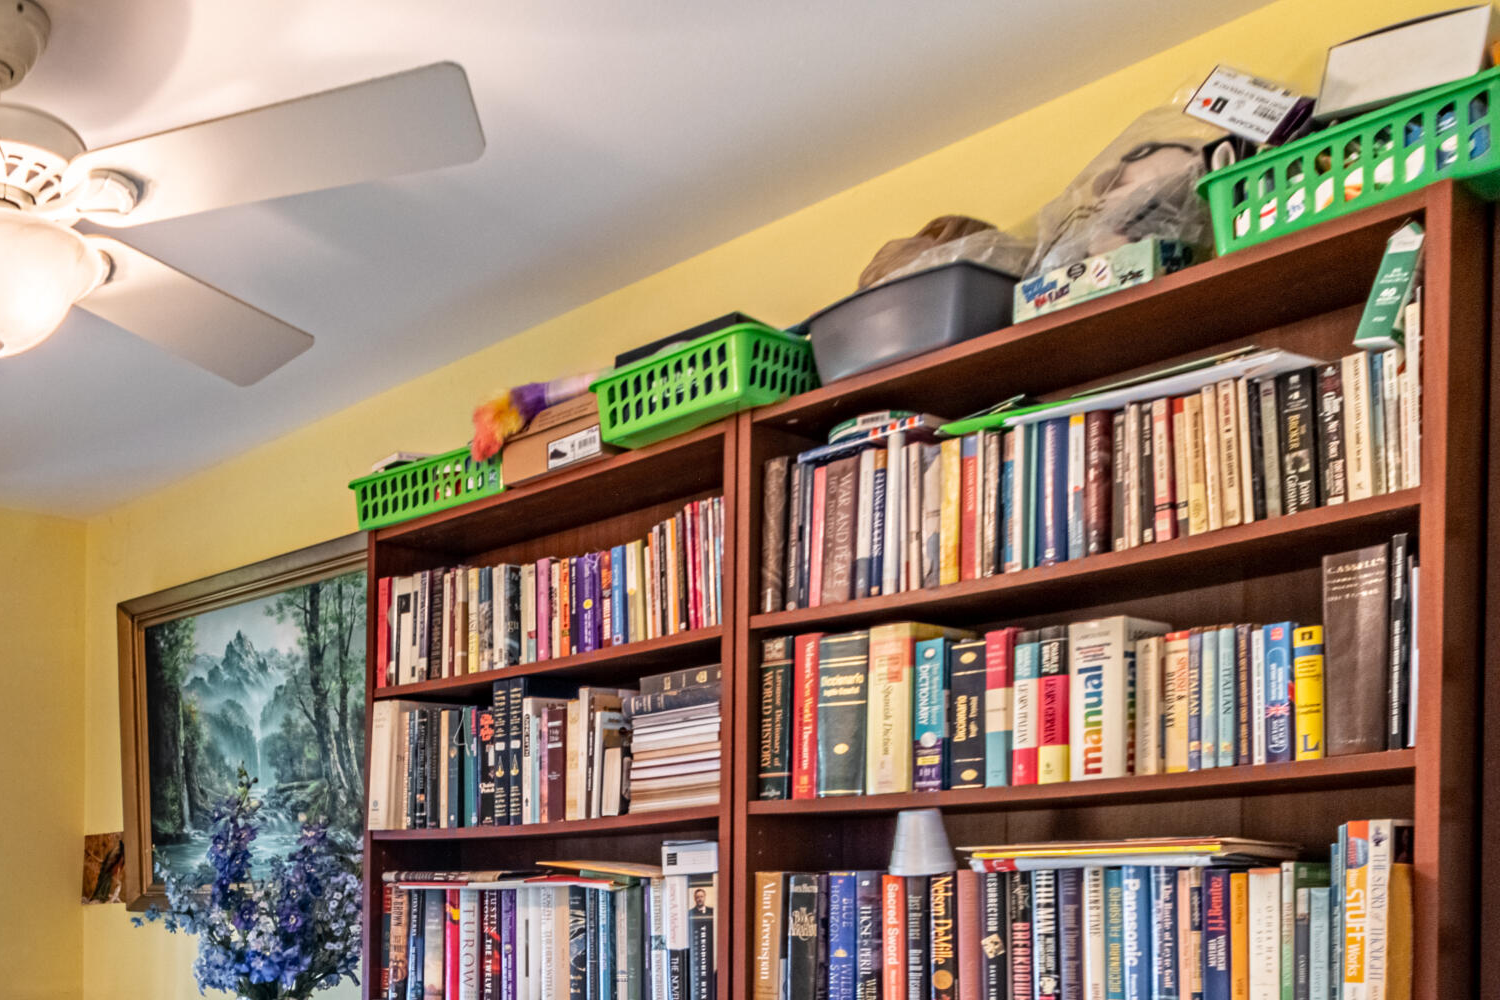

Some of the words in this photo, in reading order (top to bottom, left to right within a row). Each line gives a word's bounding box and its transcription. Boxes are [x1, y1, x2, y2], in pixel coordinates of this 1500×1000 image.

[1286, 414, 1301, 450] BROKER
[762, 671, 774, 716] WORLD
[918, 665, 931, 726] DICTIONARY
[1077, 665, 1103, 776] manual
[760, 719, 773, 769] HISTORY
[801, 726, 813, 770] Thesaurus
[393, 901, 405, 927] BROWN
[762, 882, 777, 911] Alan
[830, 884, 842, 943] HORIZON
[841, 897, 853, 928] BLUE
[886, 883, 900, 925] Sacred
[931, 876, 953, 917] Nelson
[1345, 888, 1367, 942] STUFF
[931, 918, 954, 966] DeMille
[1122, 878, 1142, 966] Panasonic
[461, 904, 476, 988] TUROW
[757, 912, 776, 980] Greenspan
[886, 927, 900, 965] Sword
[1346, 943, 1359, 977] Works
